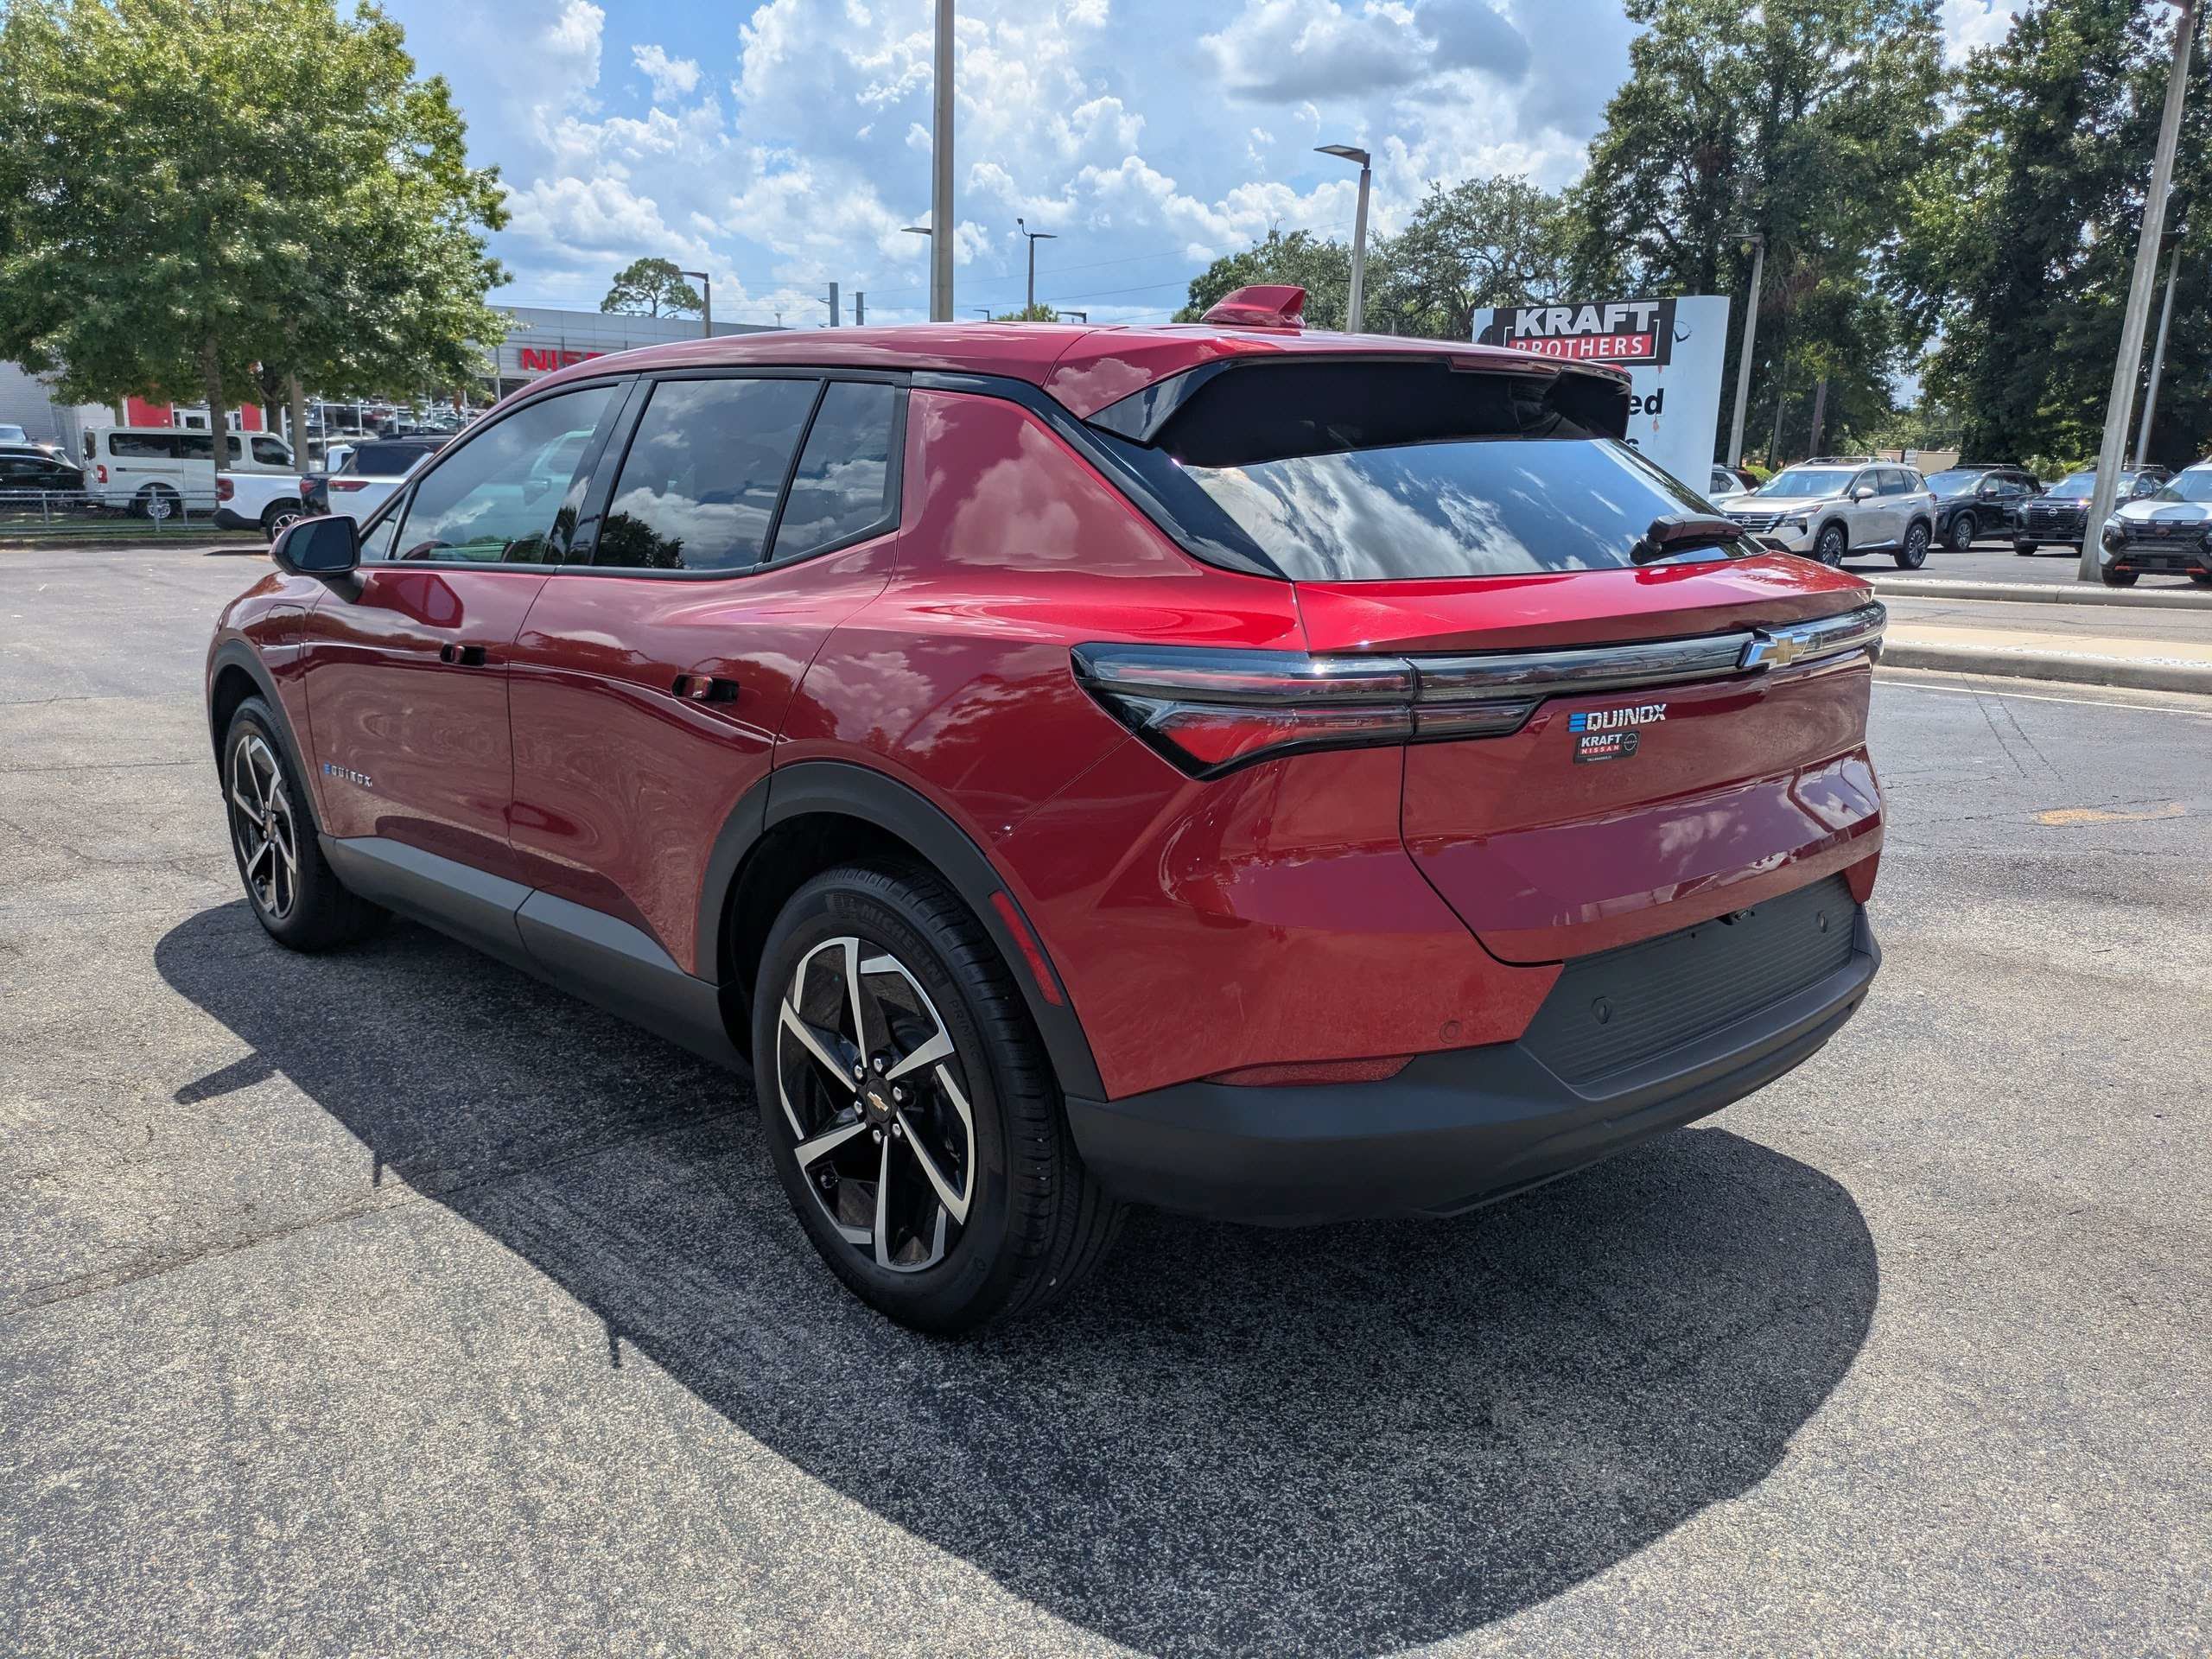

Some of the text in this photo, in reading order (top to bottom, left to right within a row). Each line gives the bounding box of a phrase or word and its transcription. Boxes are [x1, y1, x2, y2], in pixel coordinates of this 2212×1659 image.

[1514, 302, 1659, 337] KRAFT
[1630, 387, 1664, 416] ed
[1568, 703, 1667, 733] EQUINOX
[1580, 734, 1623, 747] KRAFT
[1581, 745, 1619, 754] NISSAN
[323, 761, 373, 787] EQUINOX
